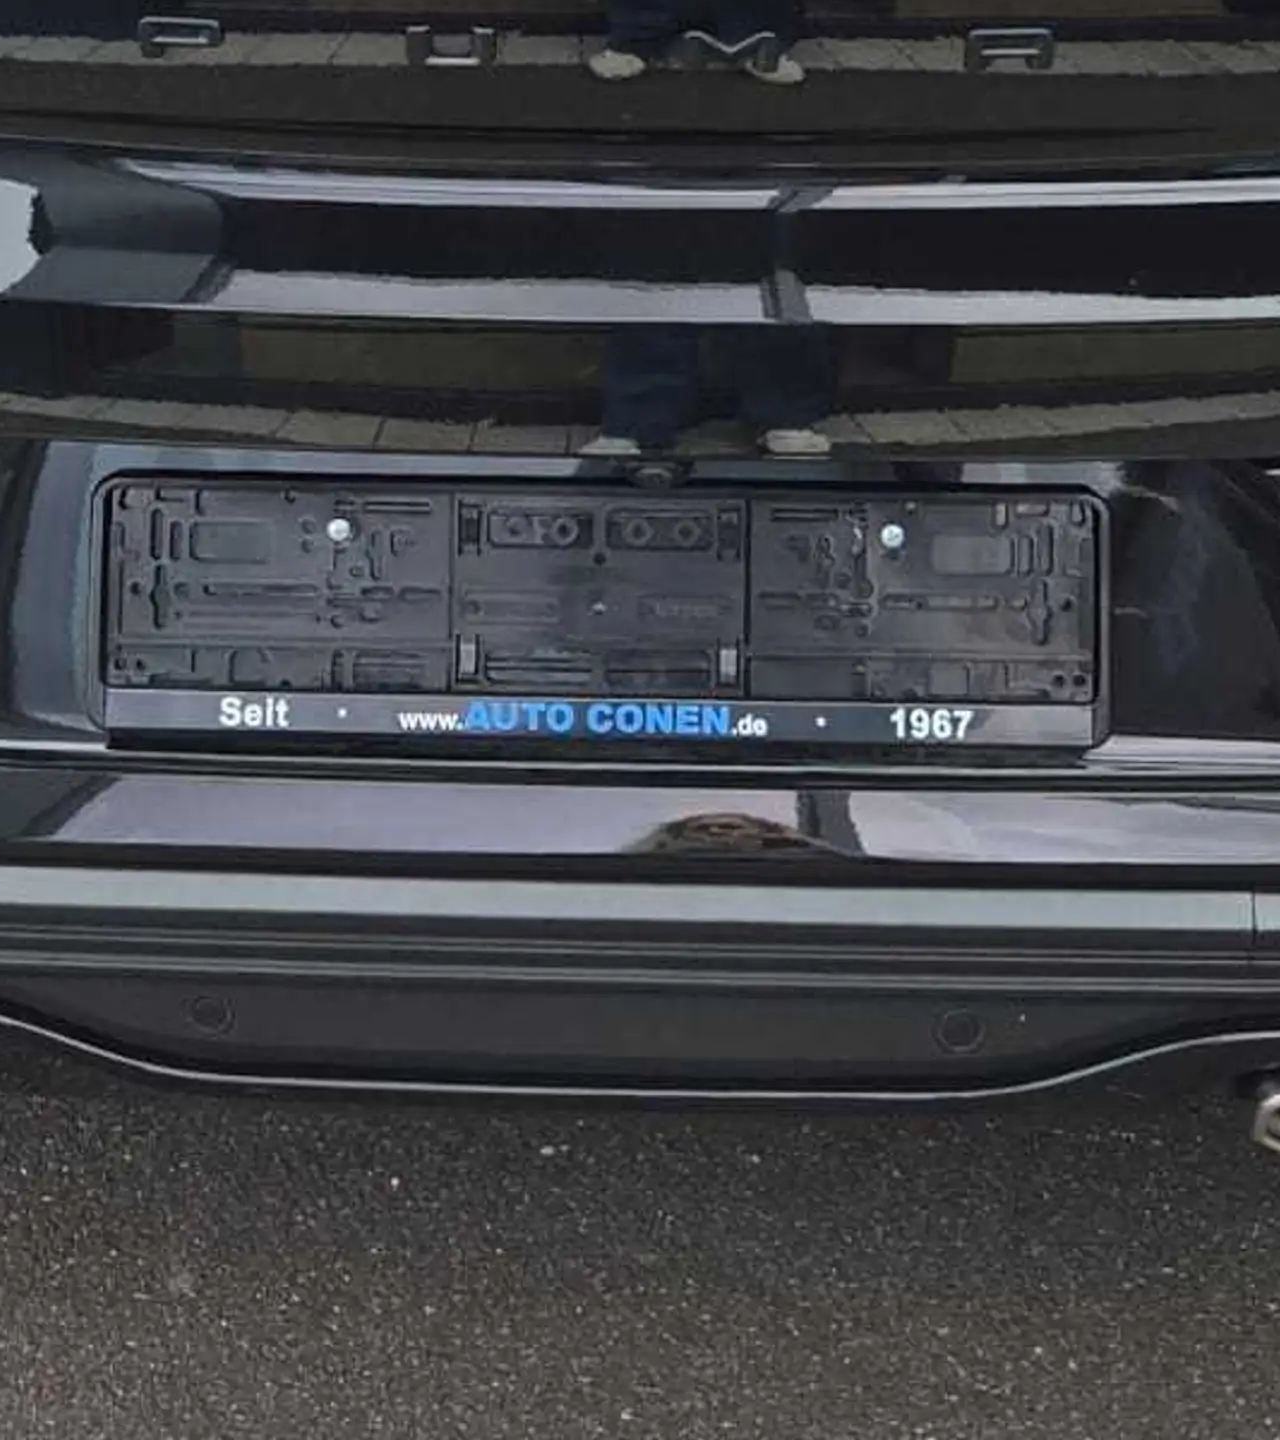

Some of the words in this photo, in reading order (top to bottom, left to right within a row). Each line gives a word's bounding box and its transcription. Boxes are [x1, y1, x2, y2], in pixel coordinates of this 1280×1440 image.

[138, 16, 1057, 74] PUMA
[219, 696, 290, 728] Seit
[397, 700, 575, 733] www.AUTO
[586, 704, 769, 737] CONEN.de
[888, 708, 976, 740] 1967
